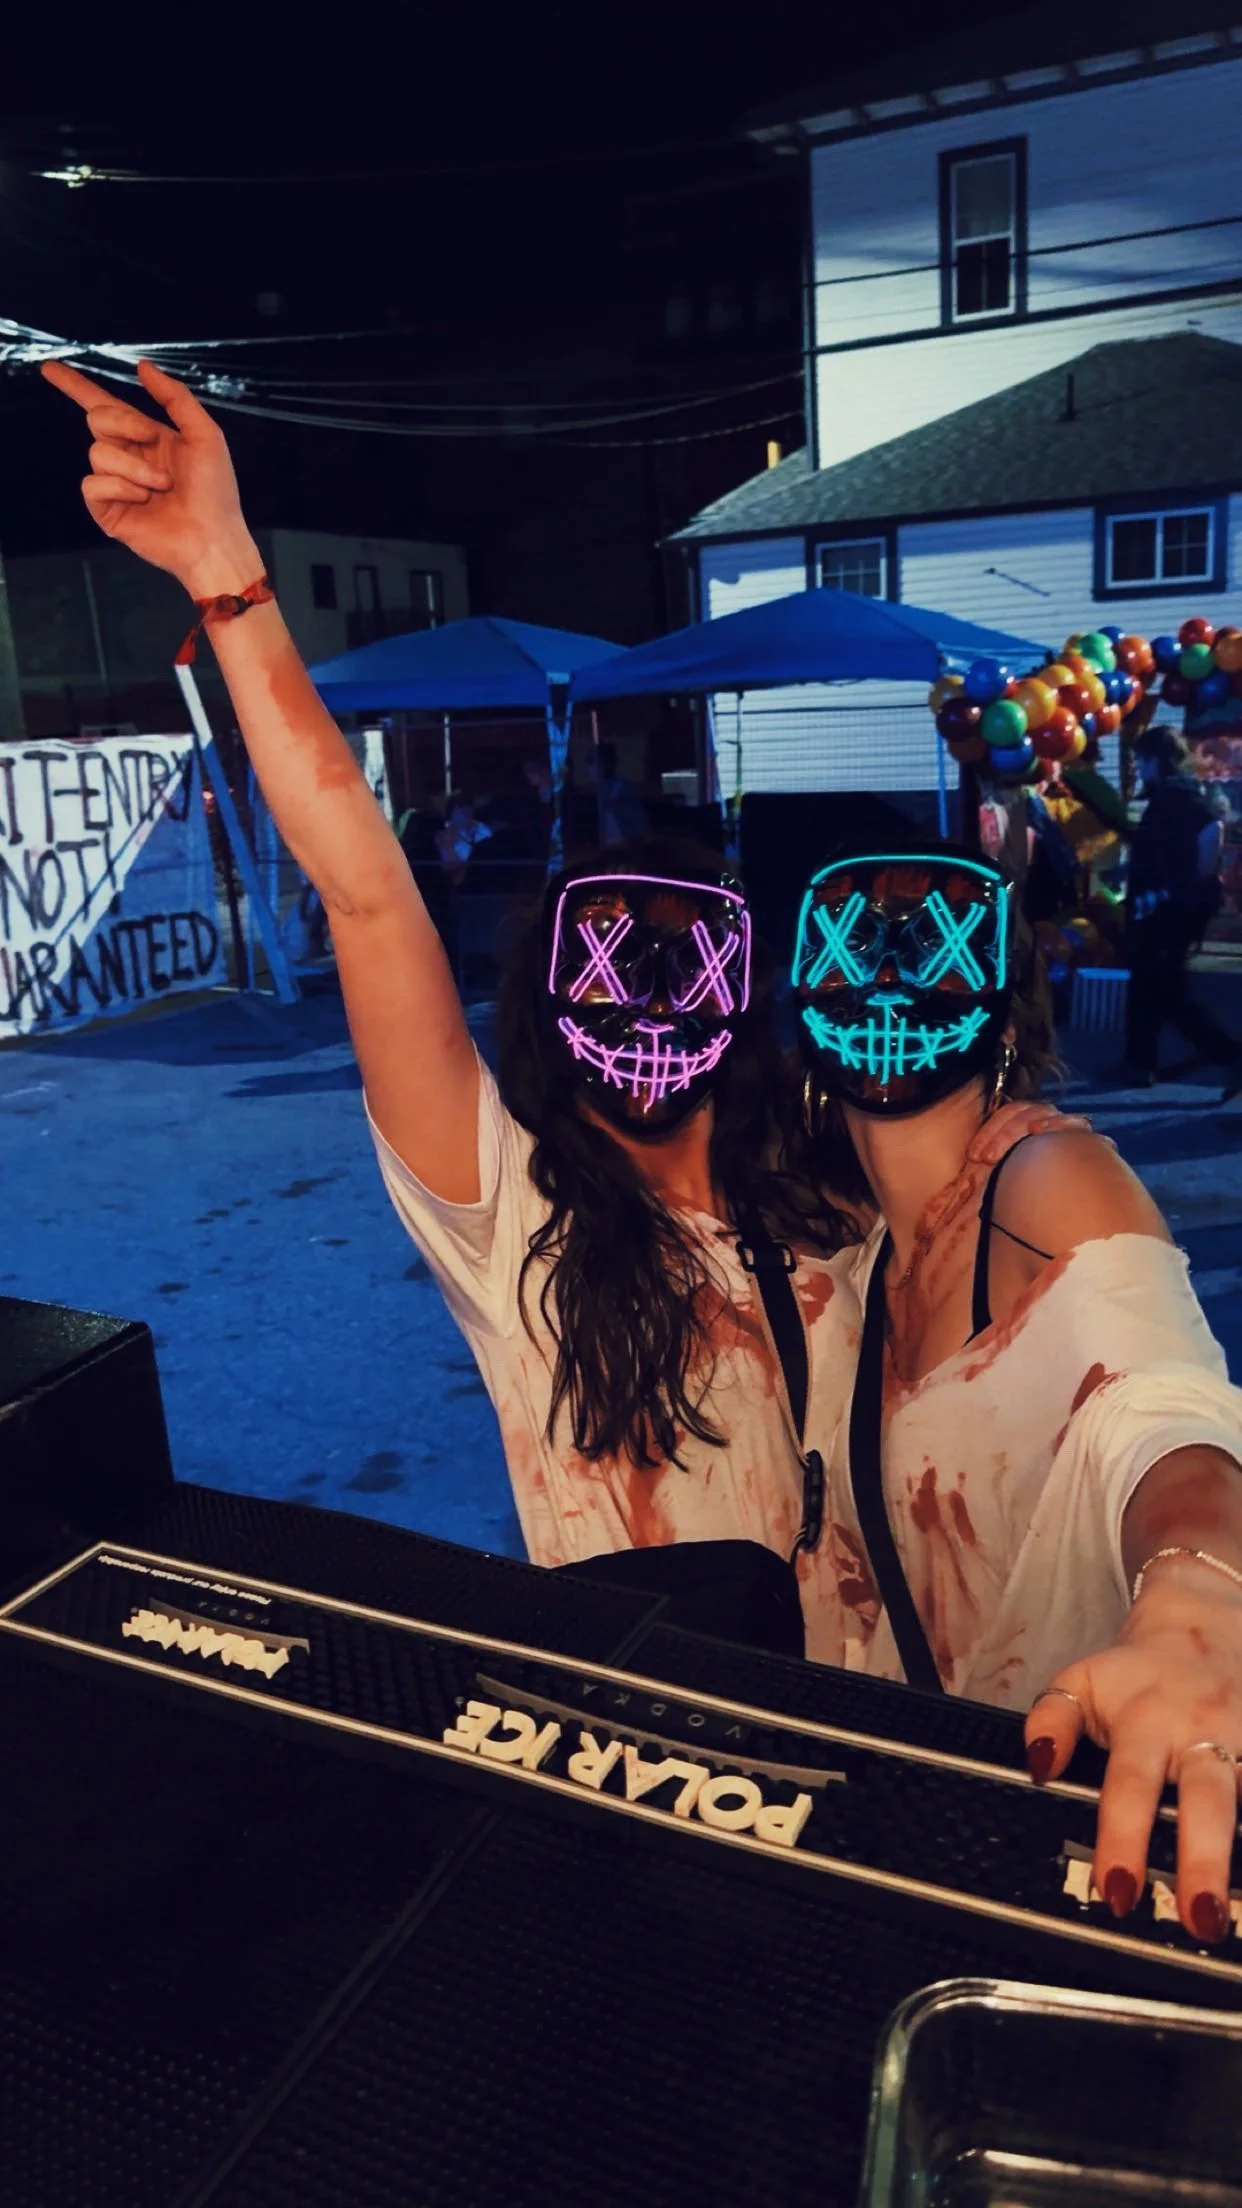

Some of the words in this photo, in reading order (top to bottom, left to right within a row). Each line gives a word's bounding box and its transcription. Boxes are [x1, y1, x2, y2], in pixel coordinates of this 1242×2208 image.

[0, 749, 193, 845] IT-ENTRY
[443, 1700, 561, 1771] ICE
[583, 1682, 743, 1739] VODKA
[568, 1731, 812, 1847] POLAR
